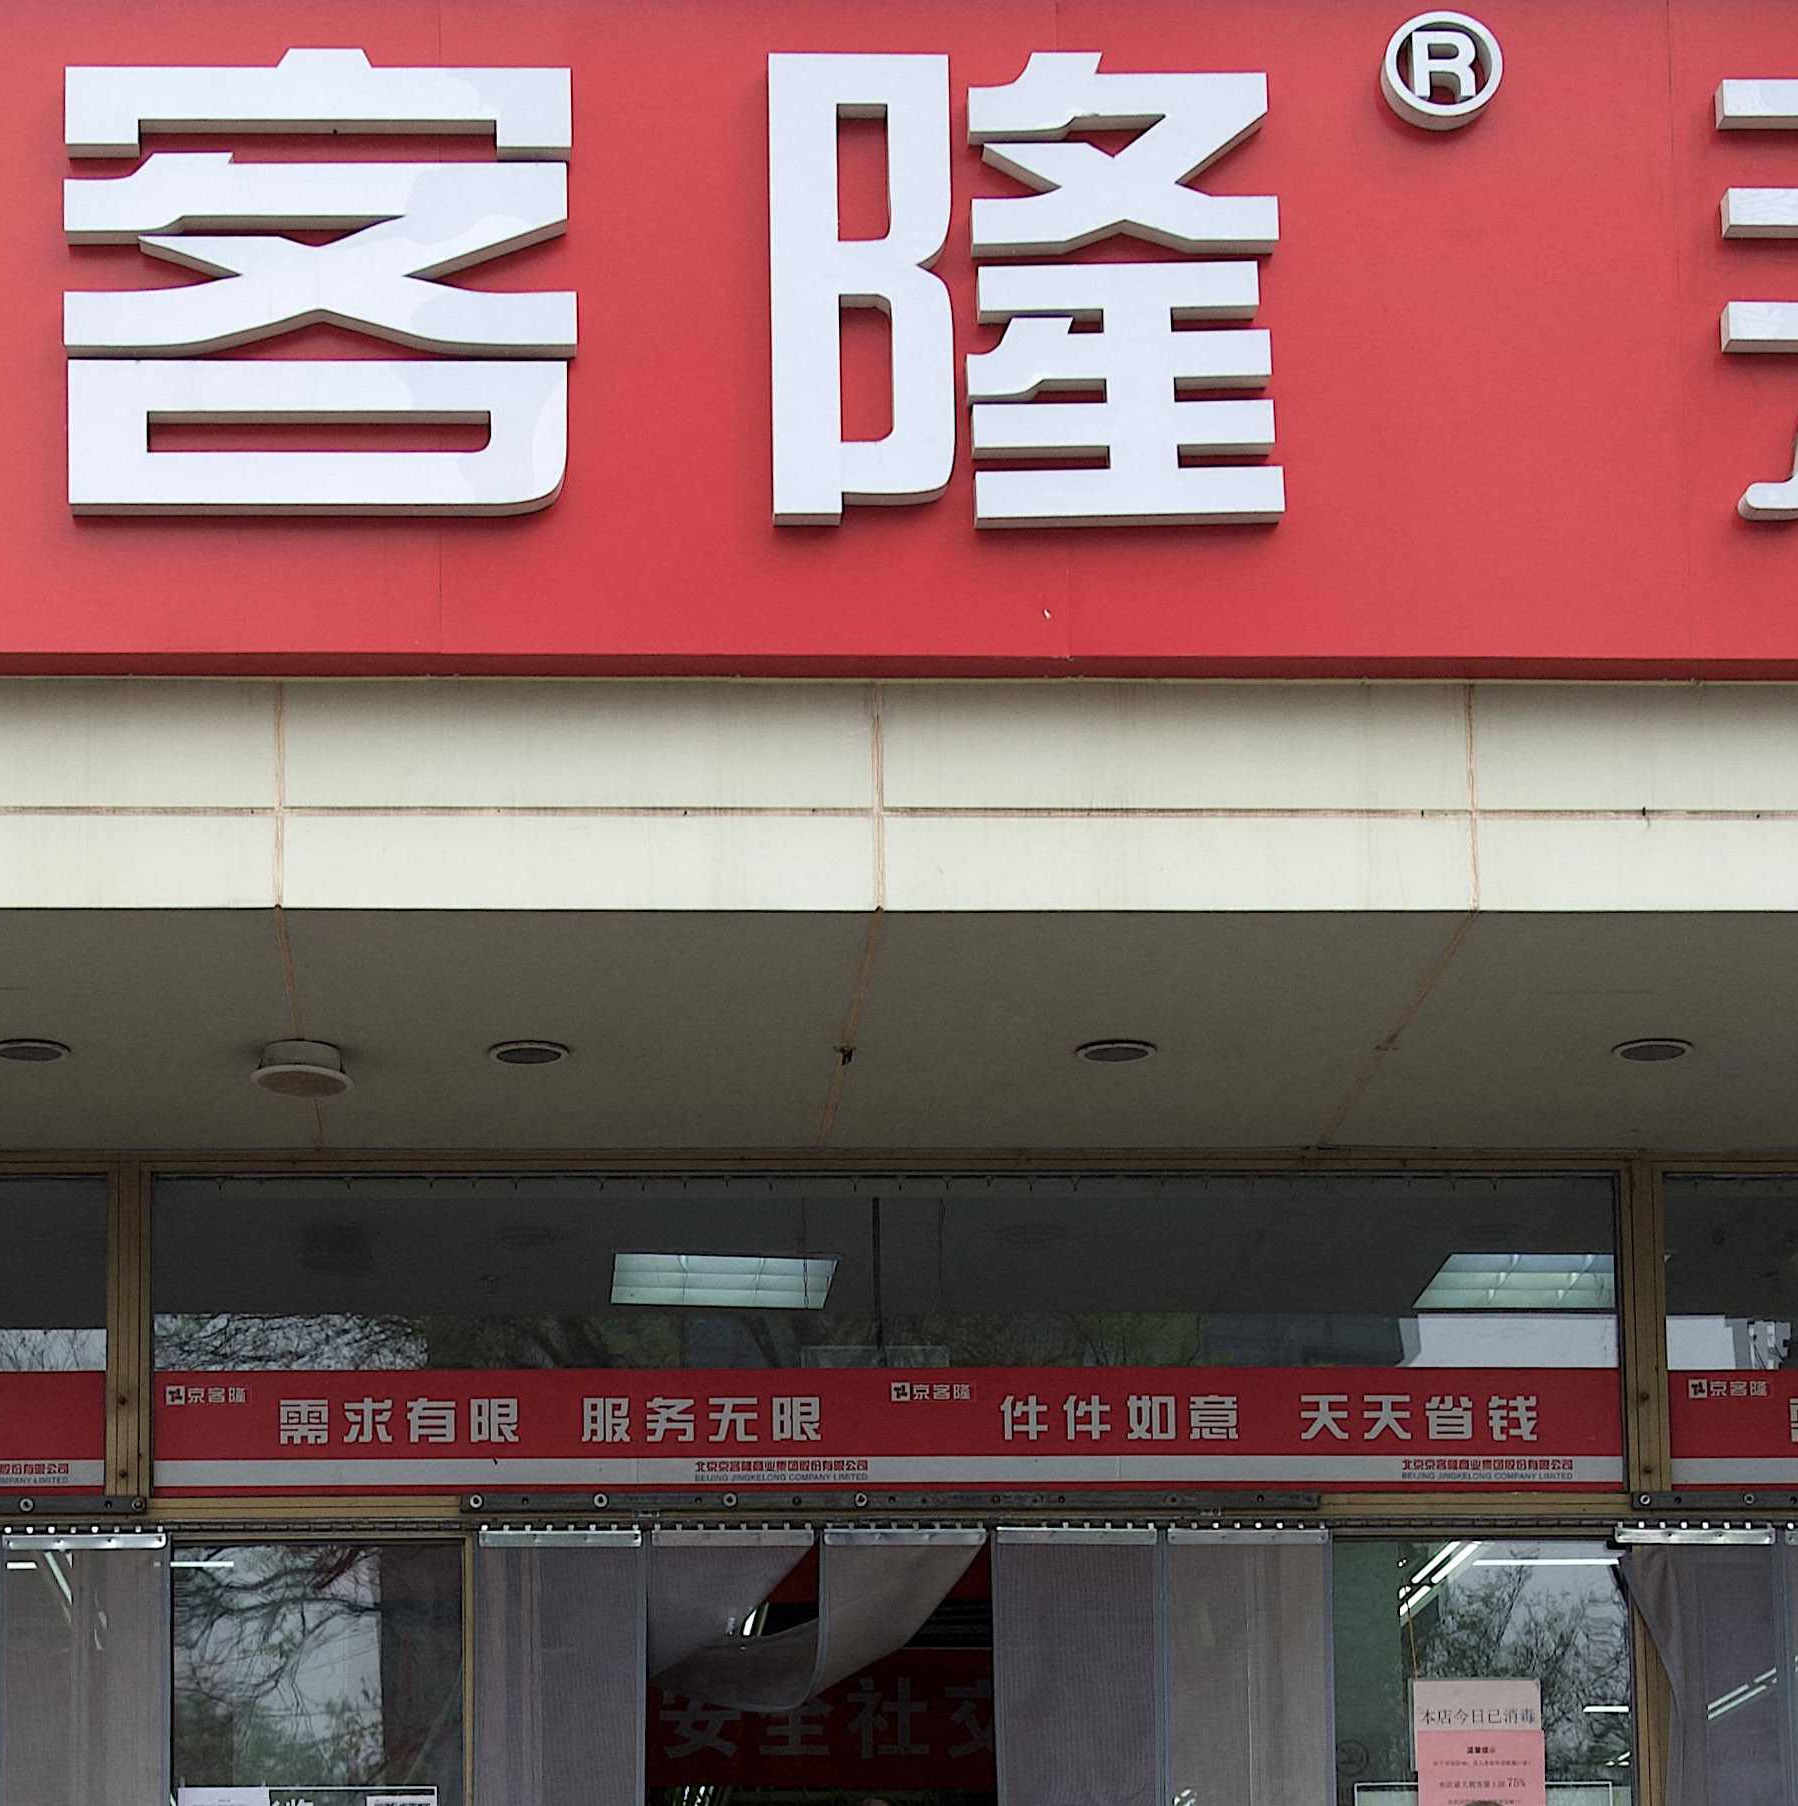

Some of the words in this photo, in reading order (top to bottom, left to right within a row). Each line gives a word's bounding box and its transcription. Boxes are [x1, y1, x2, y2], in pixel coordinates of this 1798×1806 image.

[187, 1387, 246, 1404] 京客隆
[912, 1383, 971, 1400] 京客隆
[1709, 1380, 1768, 1397] 京客隆
[279, 1396, 520, 1445] 需求有限
[581, 1396, 822, 1443] 服务无限
[1000, 1394, 1239, 1441] 件件如意
[1300, 1394, 1538, 1441] 天天省钱
[1421, 1708, 1536, 1726] 本店今日已消毒
